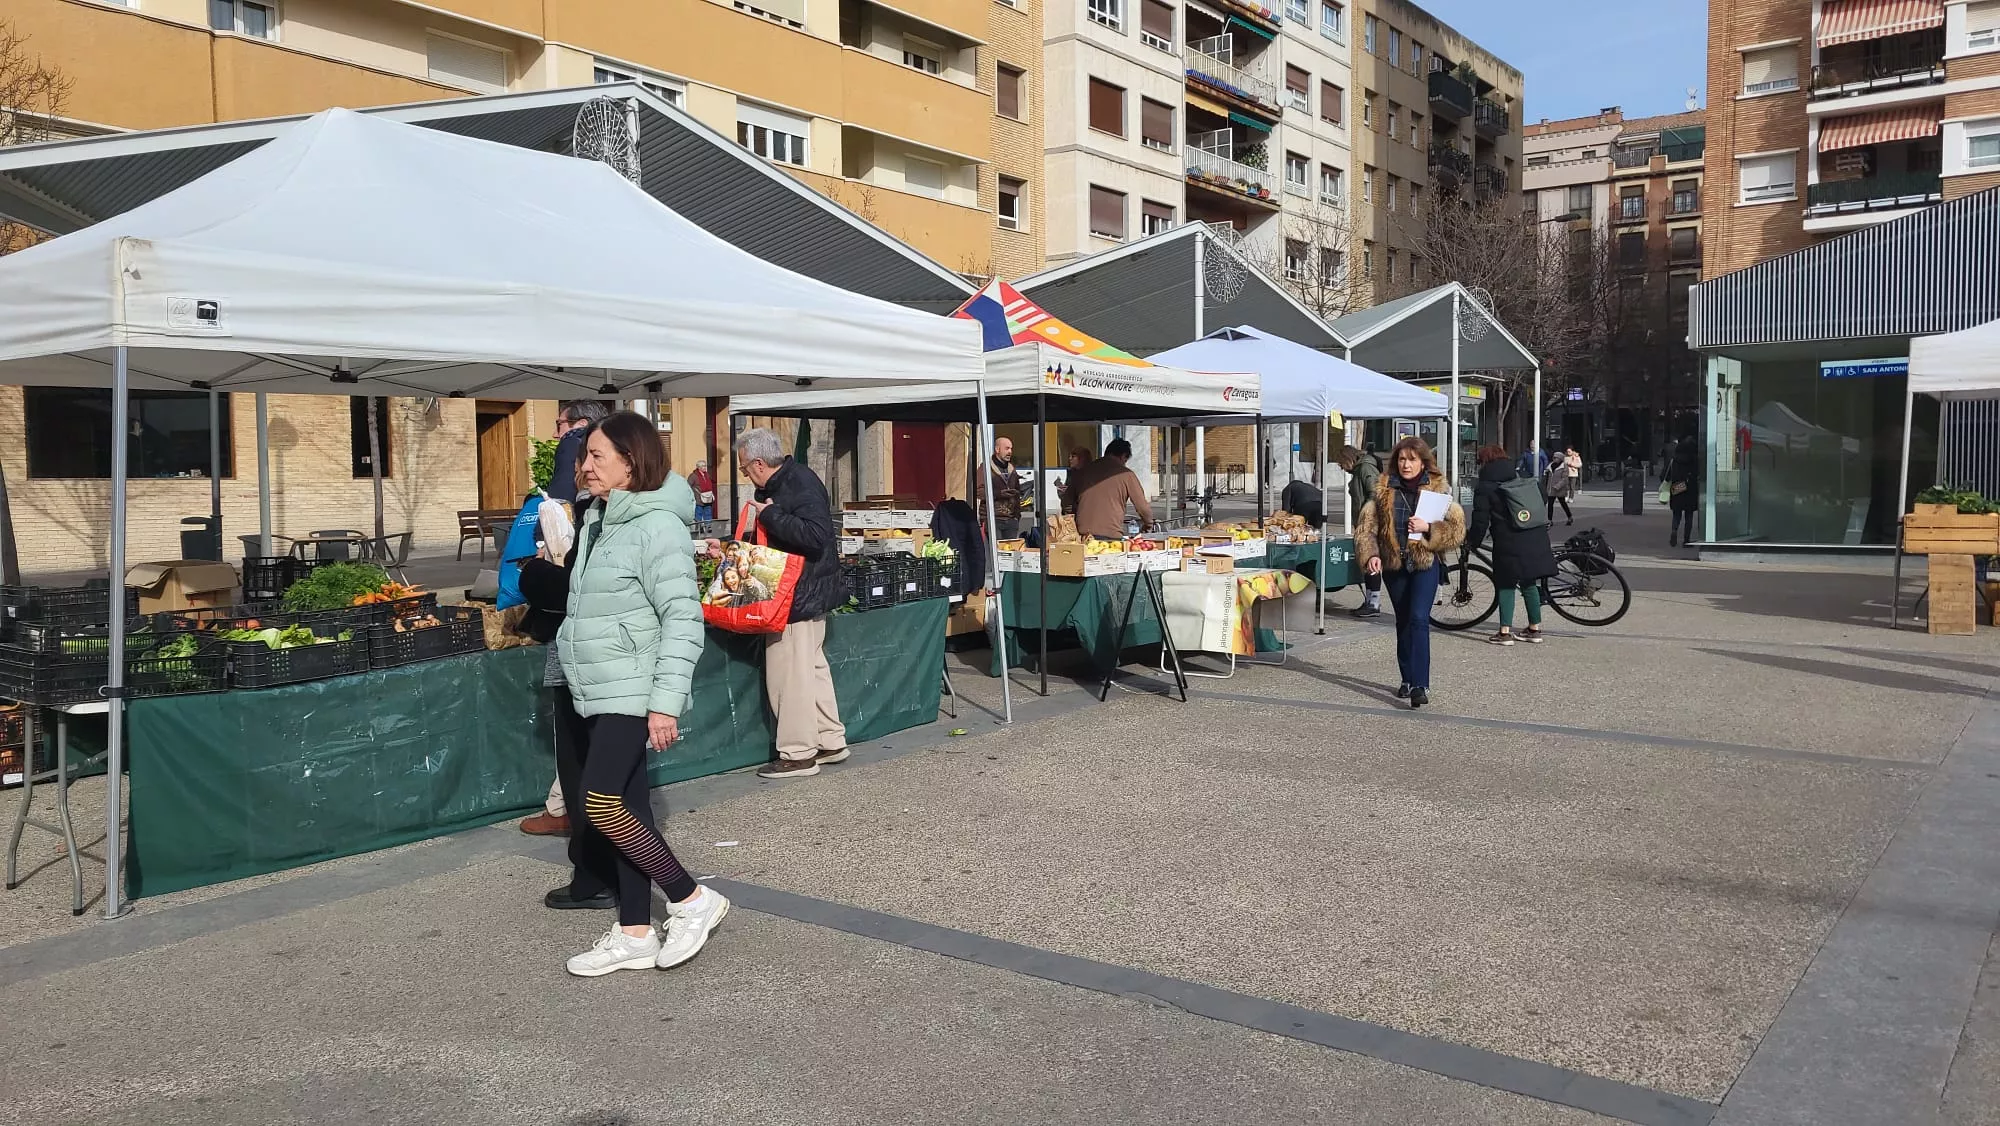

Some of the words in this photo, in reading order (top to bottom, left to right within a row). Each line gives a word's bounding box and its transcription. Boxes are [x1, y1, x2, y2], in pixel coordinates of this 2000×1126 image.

[1823, 368, 1831, 377] P
[1879, 365, 1909, 373] ANTONI
[1079, 376, 1105, 388] JALÓN
[1104, 380, 1135, 392] NATURE
[1231, 388, 1259, 401] Zaragoza
